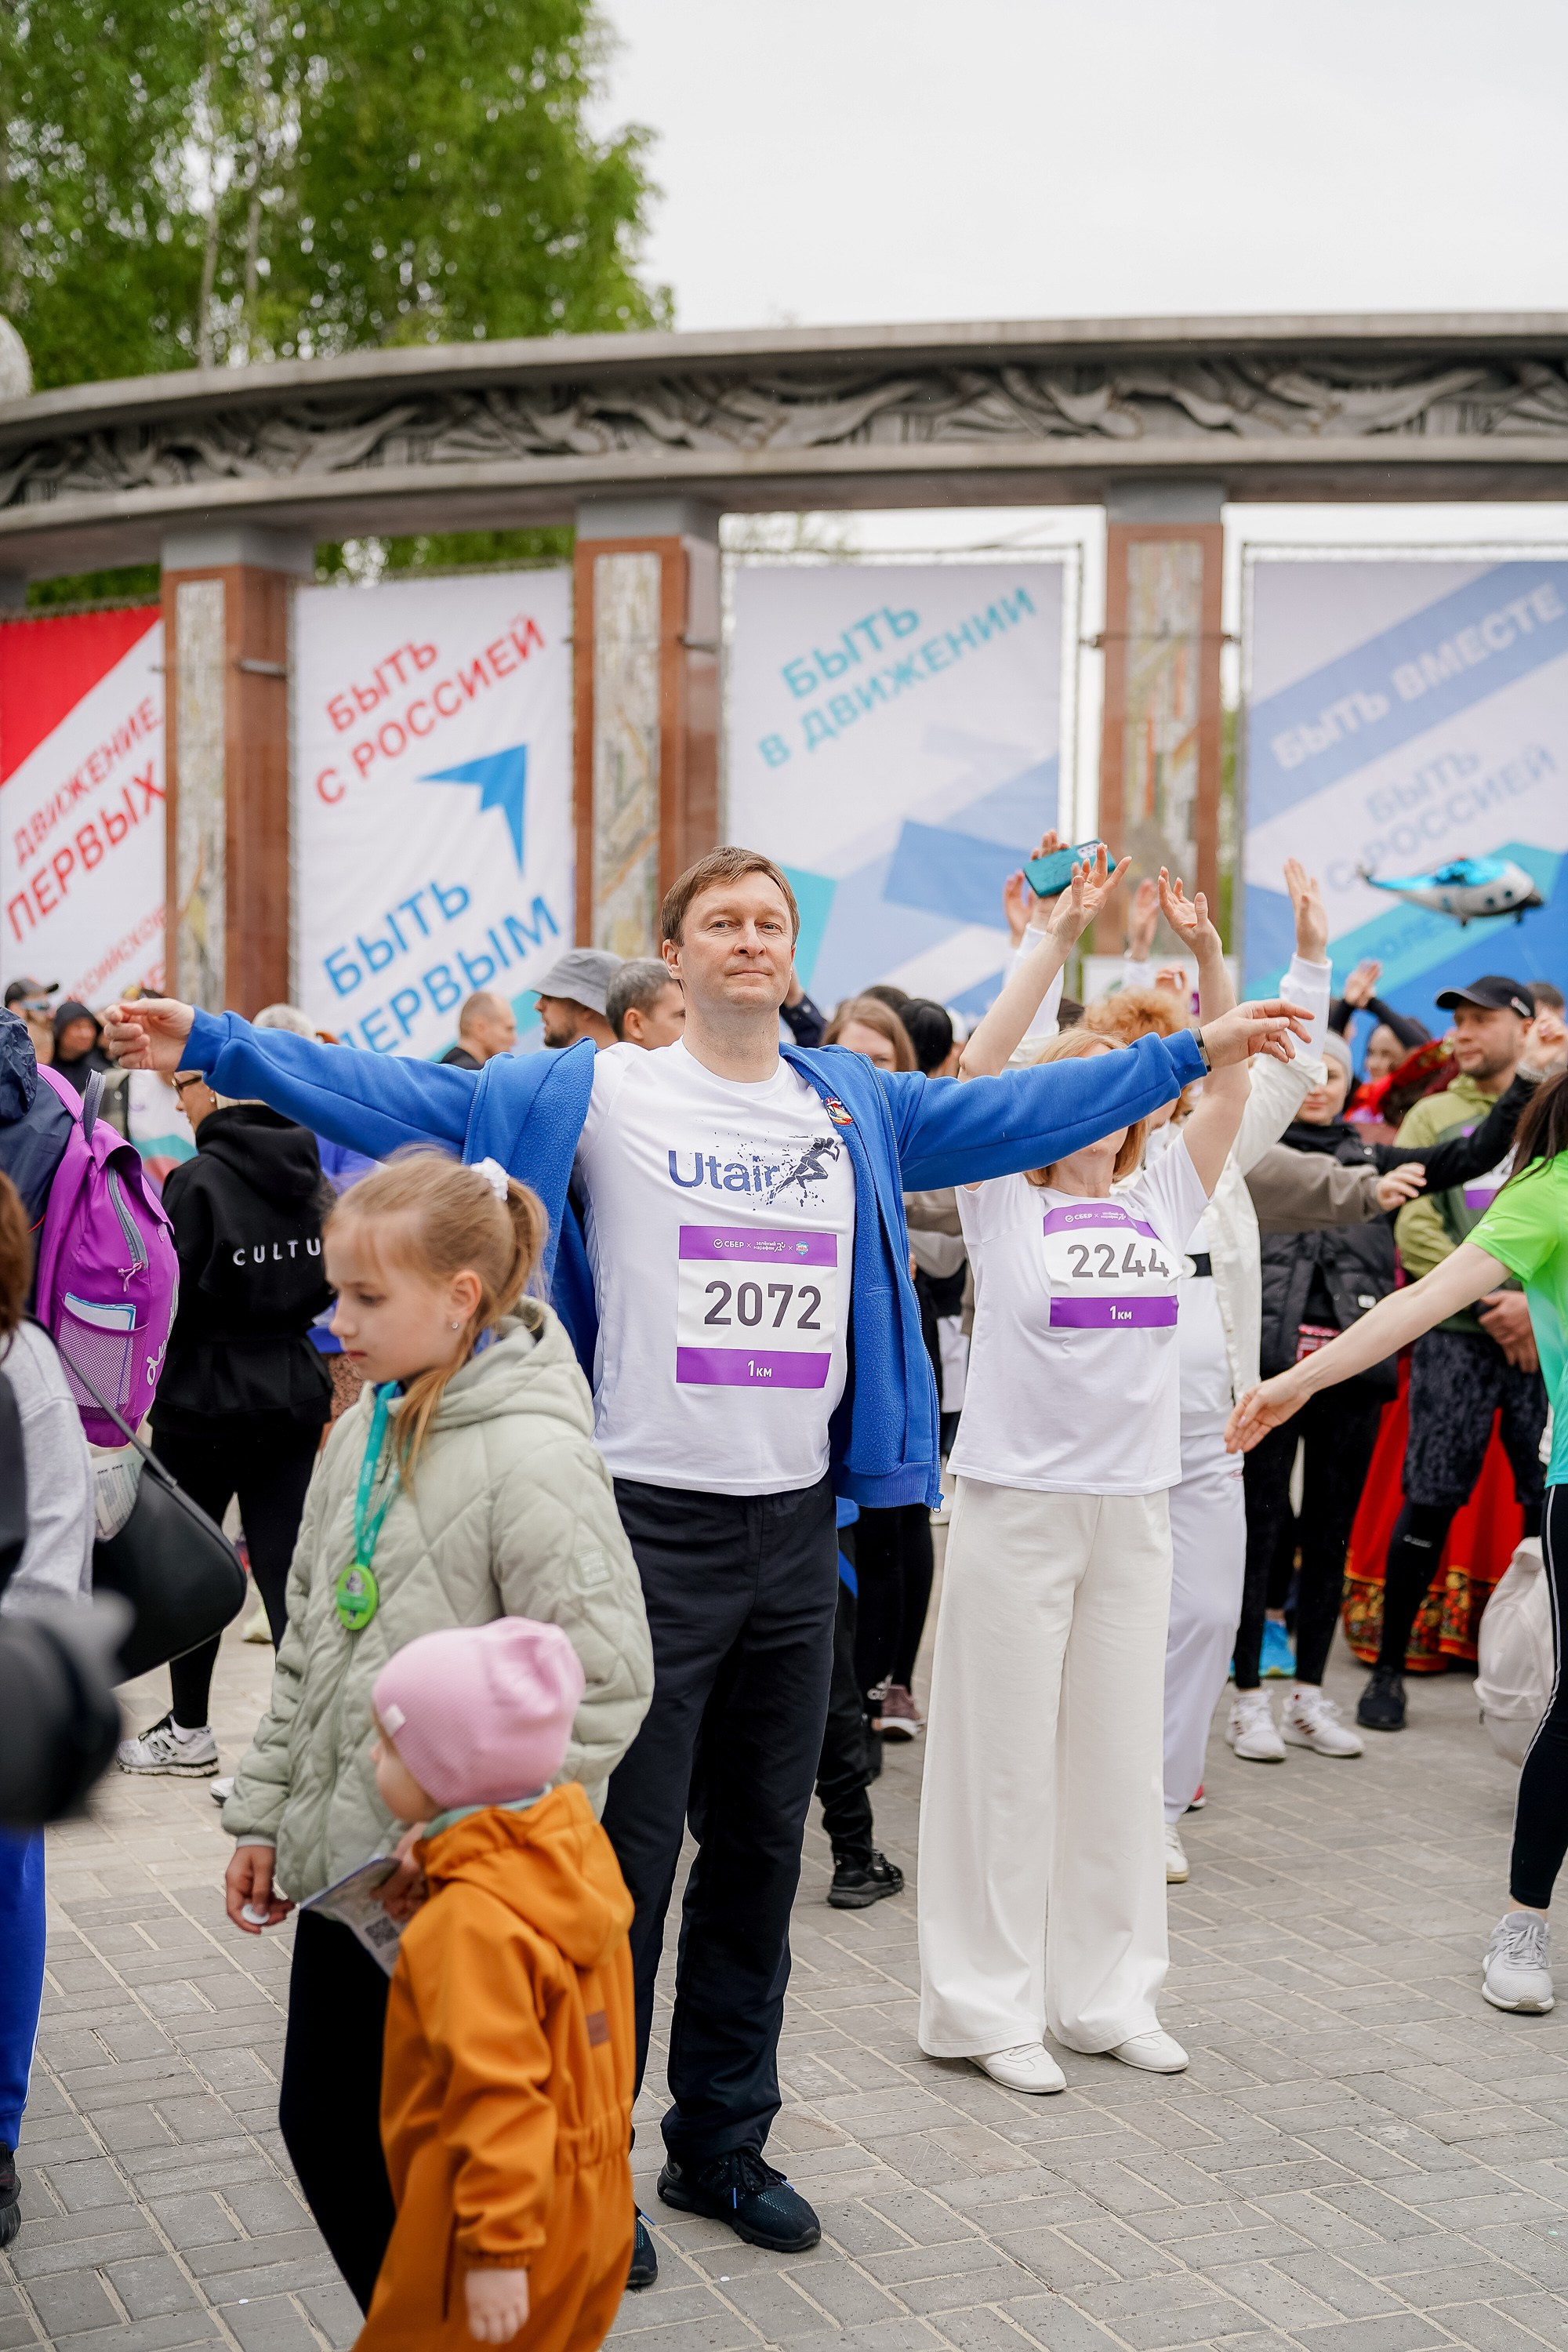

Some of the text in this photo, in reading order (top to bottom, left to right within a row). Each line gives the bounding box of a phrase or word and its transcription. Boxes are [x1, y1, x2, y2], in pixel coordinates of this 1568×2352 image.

[325, 641, 438, 731] БЫТЬ
[758, 587, 1036, 768] В ДВИЖЕНИИ
[782, 606, 920, 699] БЫТЬ
[1272, 583, 1566, 771] БЫТЬ ВМЕСТЕ
[316, 613, 546, 804] С РОССИЕЙ
[13, 695, 162, 871] ДВИЖЕНИЕ
[1364, 753, 1479, 823] БЫТЬ
[6, 760, 165, 943] ПЕРВЫХ
[322, 880, 470, 996] БЫТЬ
[668, 1150, 781, 1192] Utair
[232, 1237, 321, 1266] CULTU
[1067, 1243, 1170, 1278] 2244
[704, 1280, 822, 1330] 2072
